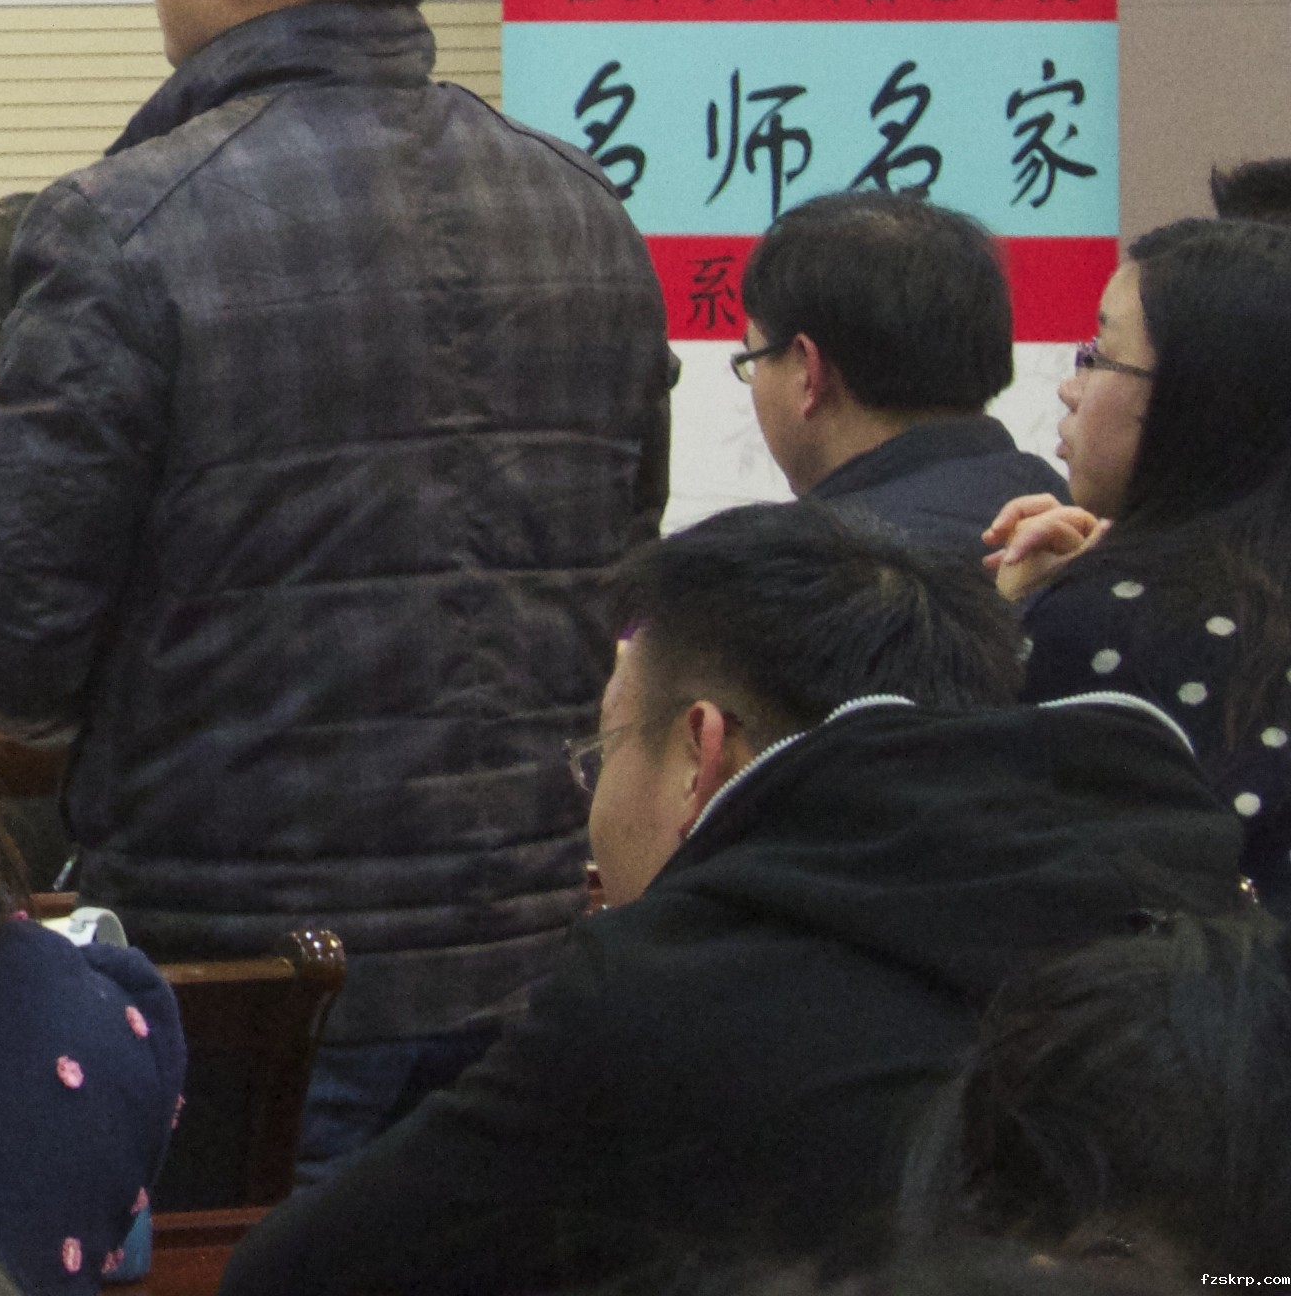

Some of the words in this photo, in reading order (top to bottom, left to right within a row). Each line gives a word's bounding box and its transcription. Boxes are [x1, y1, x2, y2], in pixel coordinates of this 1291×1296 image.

[574, 59, 1098, 222] 名师名家
[686, 256, 738, 330] 系
